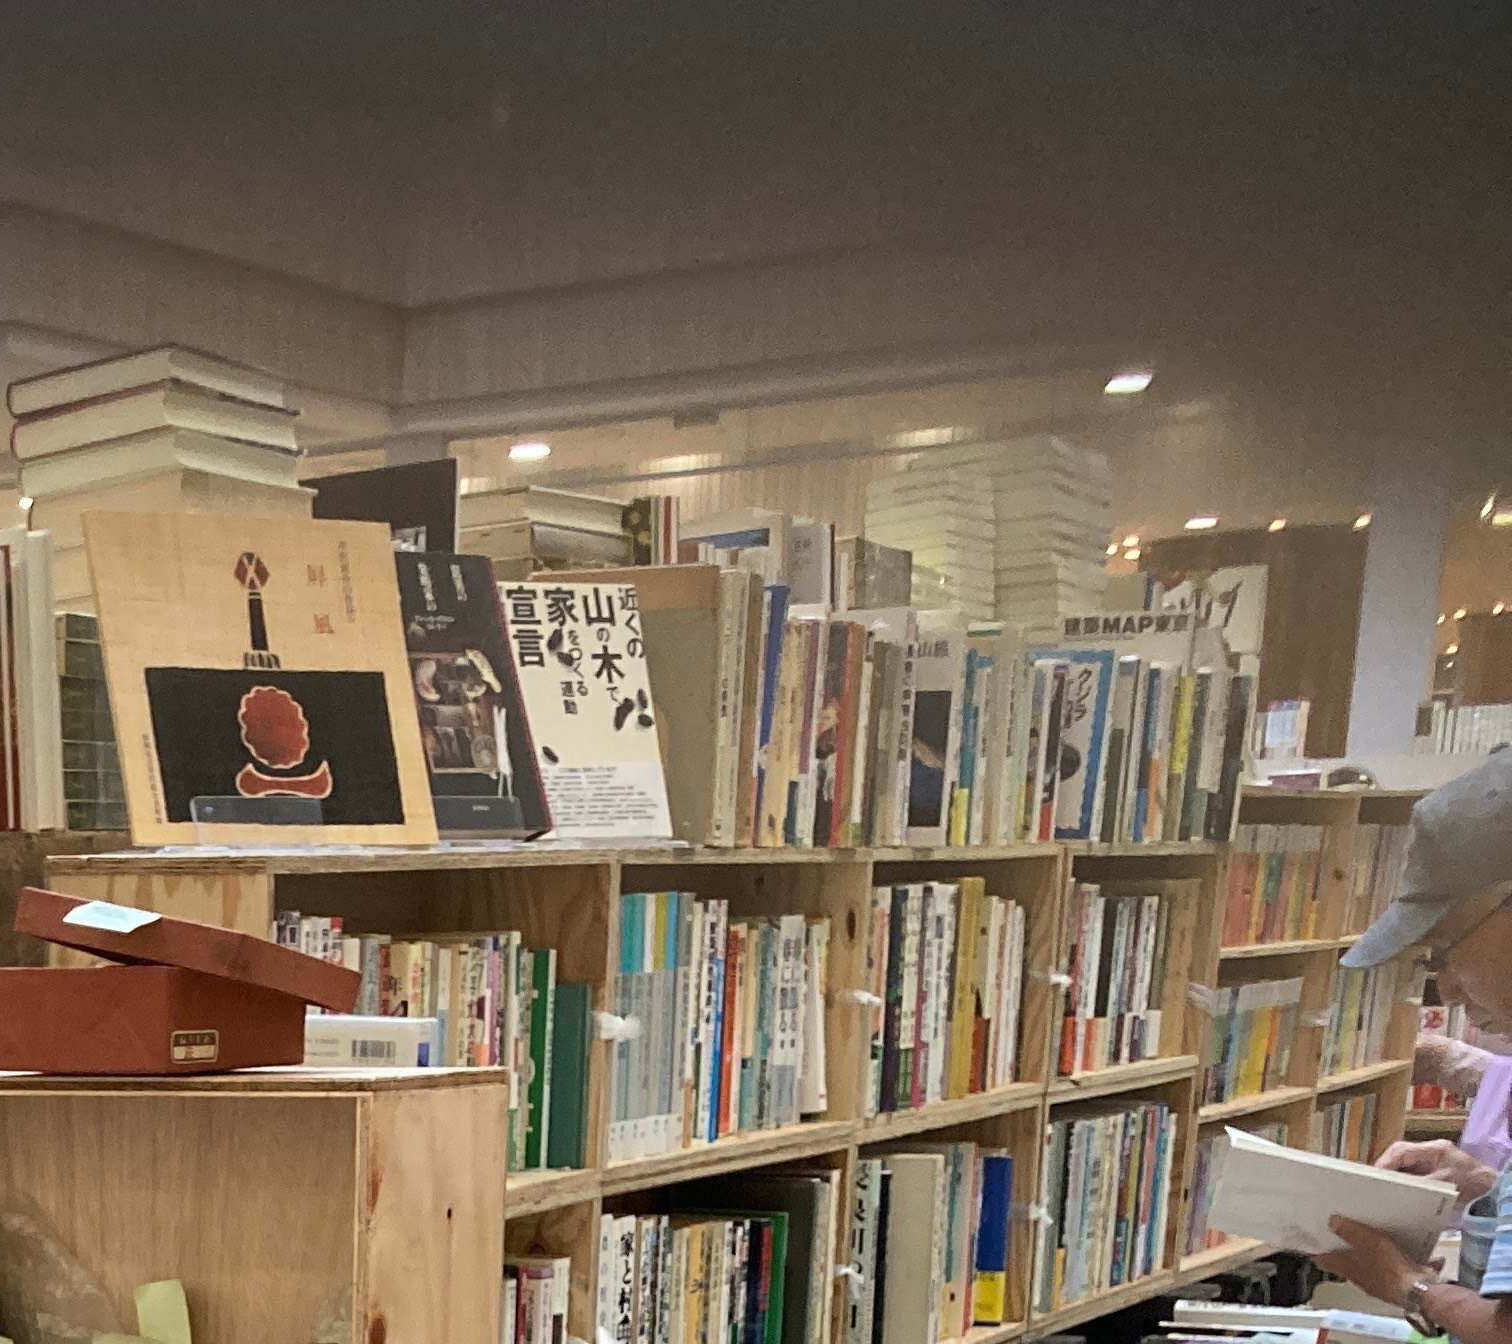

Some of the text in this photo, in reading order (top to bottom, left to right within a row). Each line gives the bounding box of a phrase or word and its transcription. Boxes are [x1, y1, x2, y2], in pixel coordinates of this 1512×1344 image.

[506, 585, 545, 667] 宣言
[581, 586, 625, 706] 山の木で
[618, 587, 645, 659] 近くの
